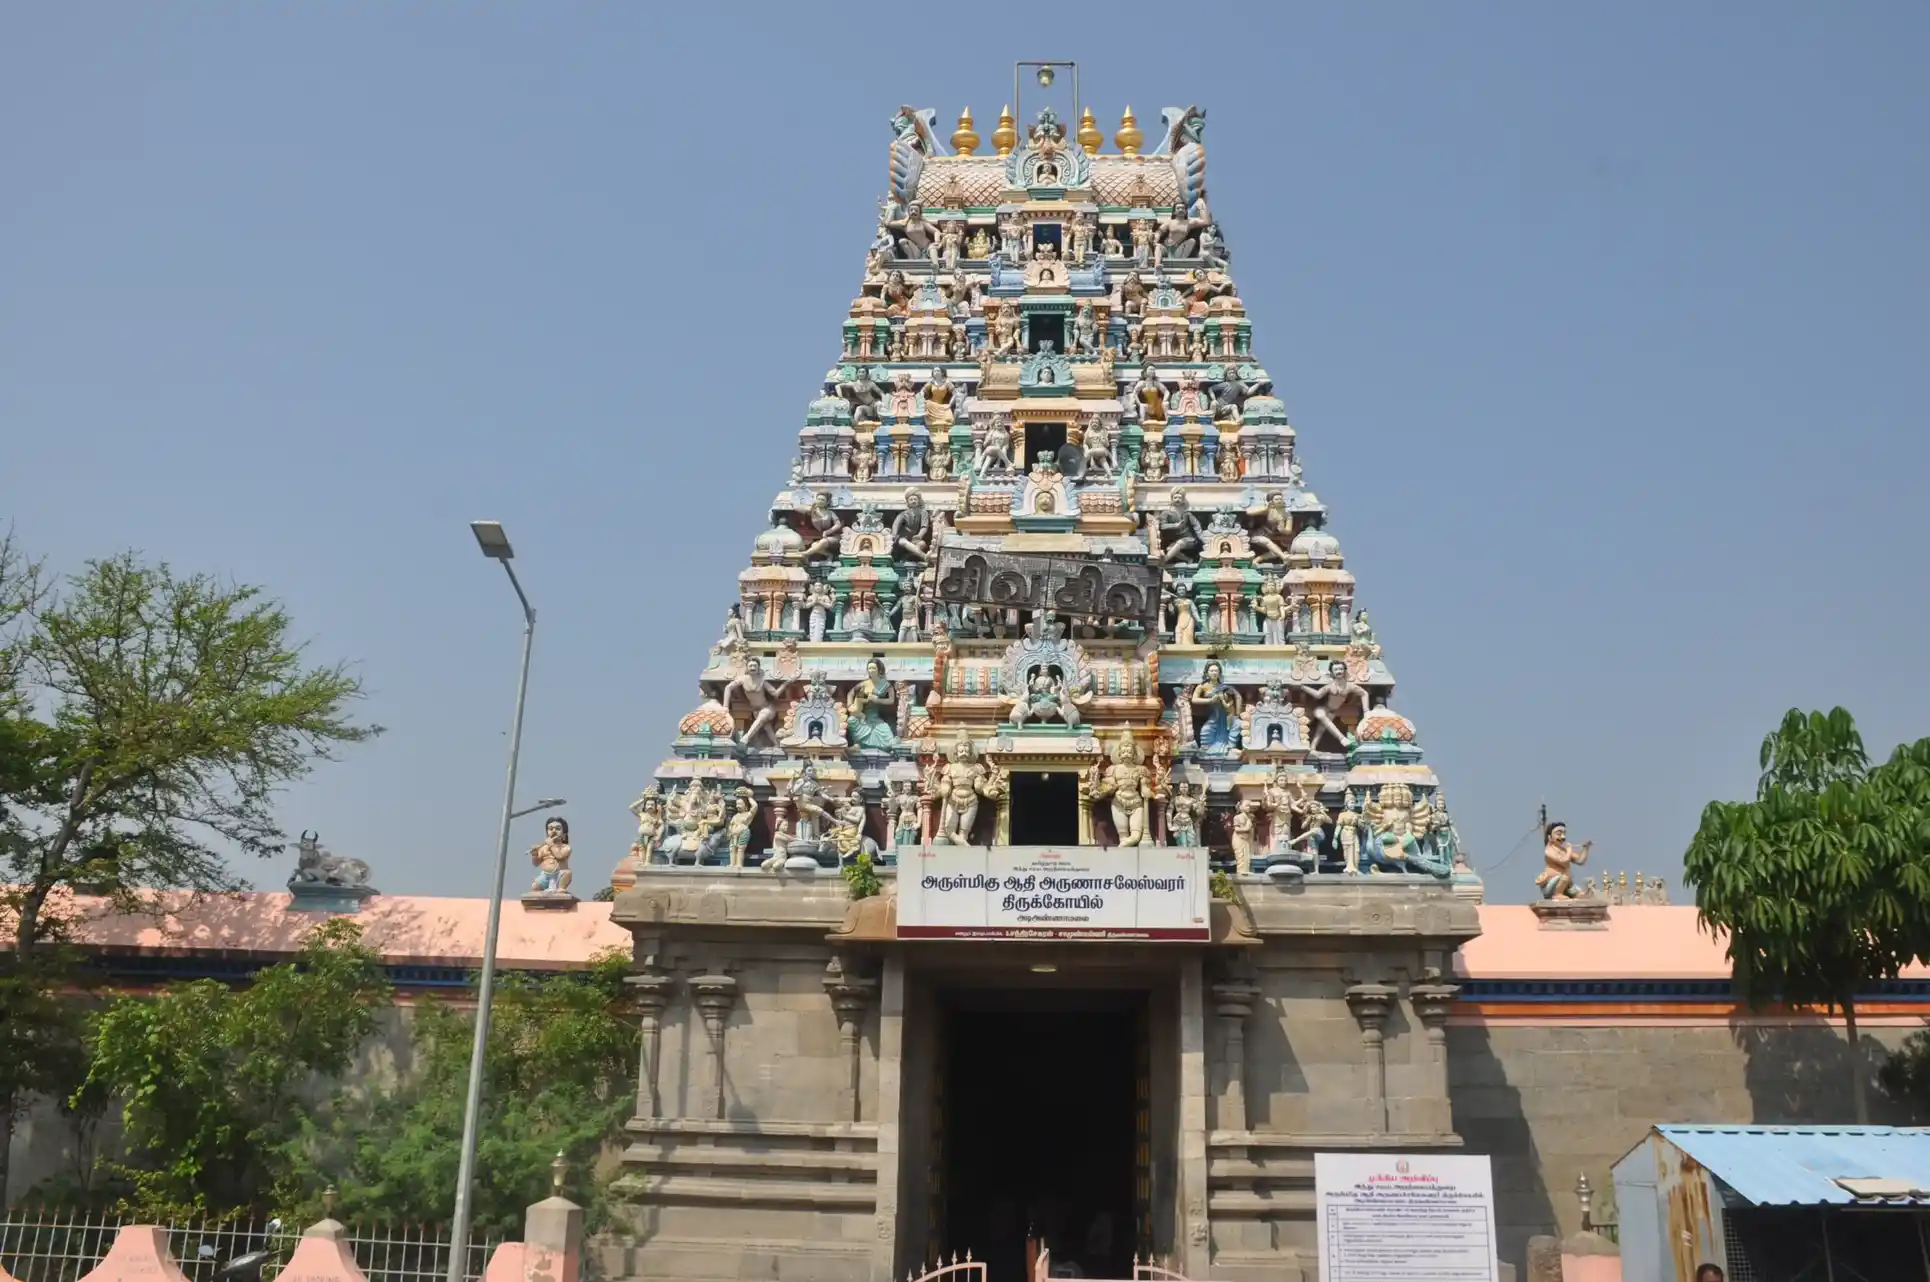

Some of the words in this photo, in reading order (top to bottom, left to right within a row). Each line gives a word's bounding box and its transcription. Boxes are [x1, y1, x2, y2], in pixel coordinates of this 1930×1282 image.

[939, 553, 1044, 608] சிவ
[1053, 564, 1158, 619] சிவ
[921, 873, 1000, 891] அருள்மிகு
[1003, 874, 1036, 892] ஆதி
[1039, 874, 1186, 892] அருணாசலேஸ்வரர்
[1001, 893, 1104, 912] திருக்கோயில்
